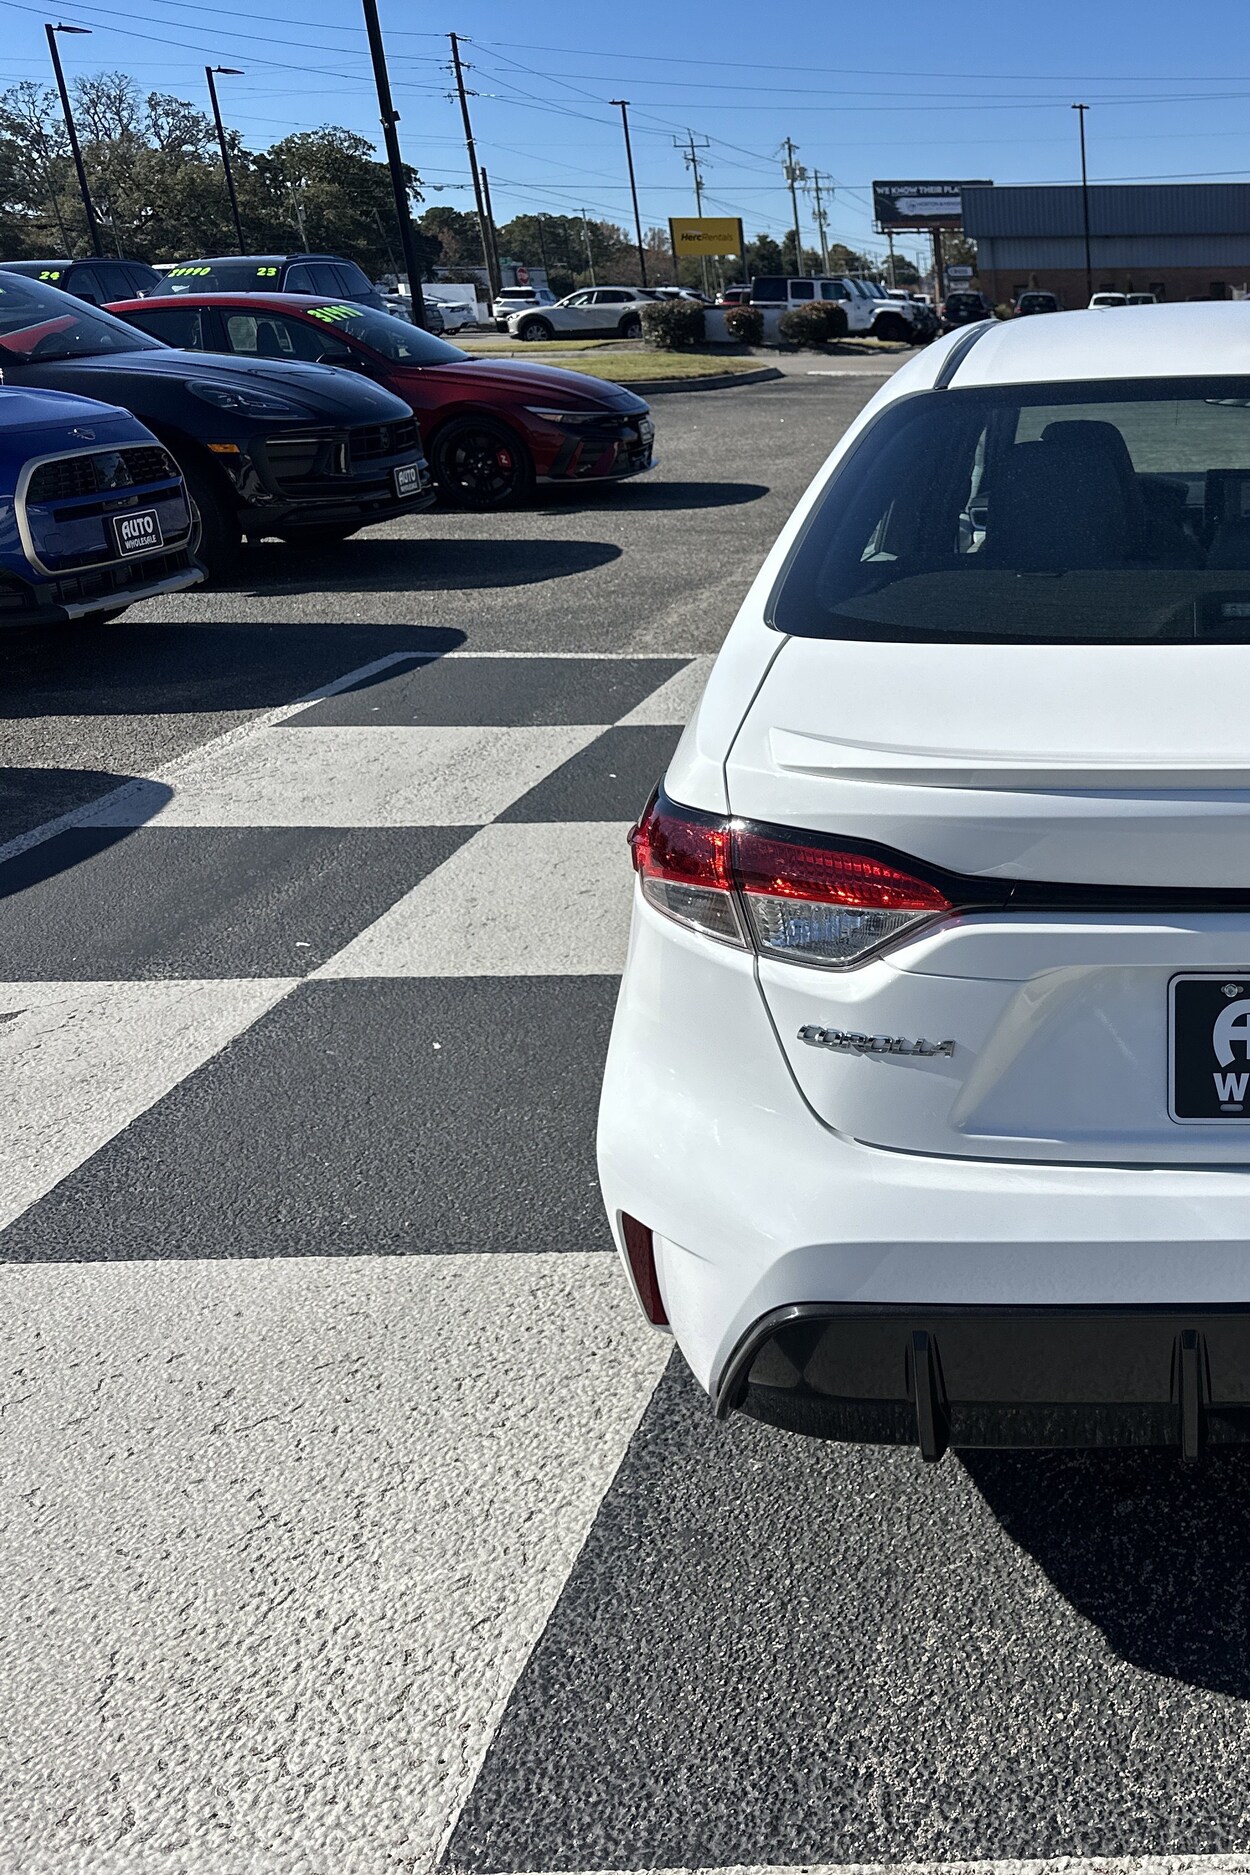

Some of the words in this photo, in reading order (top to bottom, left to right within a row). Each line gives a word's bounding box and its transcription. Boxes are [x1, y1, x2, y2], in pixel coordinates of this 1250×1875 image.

[876, 186, 889, 194] WE
[891, 186, 919, 194] KNOW
[919, 186, 943, 194] THEIR
[38, 271, 61, 281] 24
[256, 267, 278, 277] 23
[398, 468, 416, 486] AUTO
[121, 516, 153, 540] AUTO
[124, 534, 157, 550] WHOLESALE
[796, 1024, 956, 1058] COROLLA
